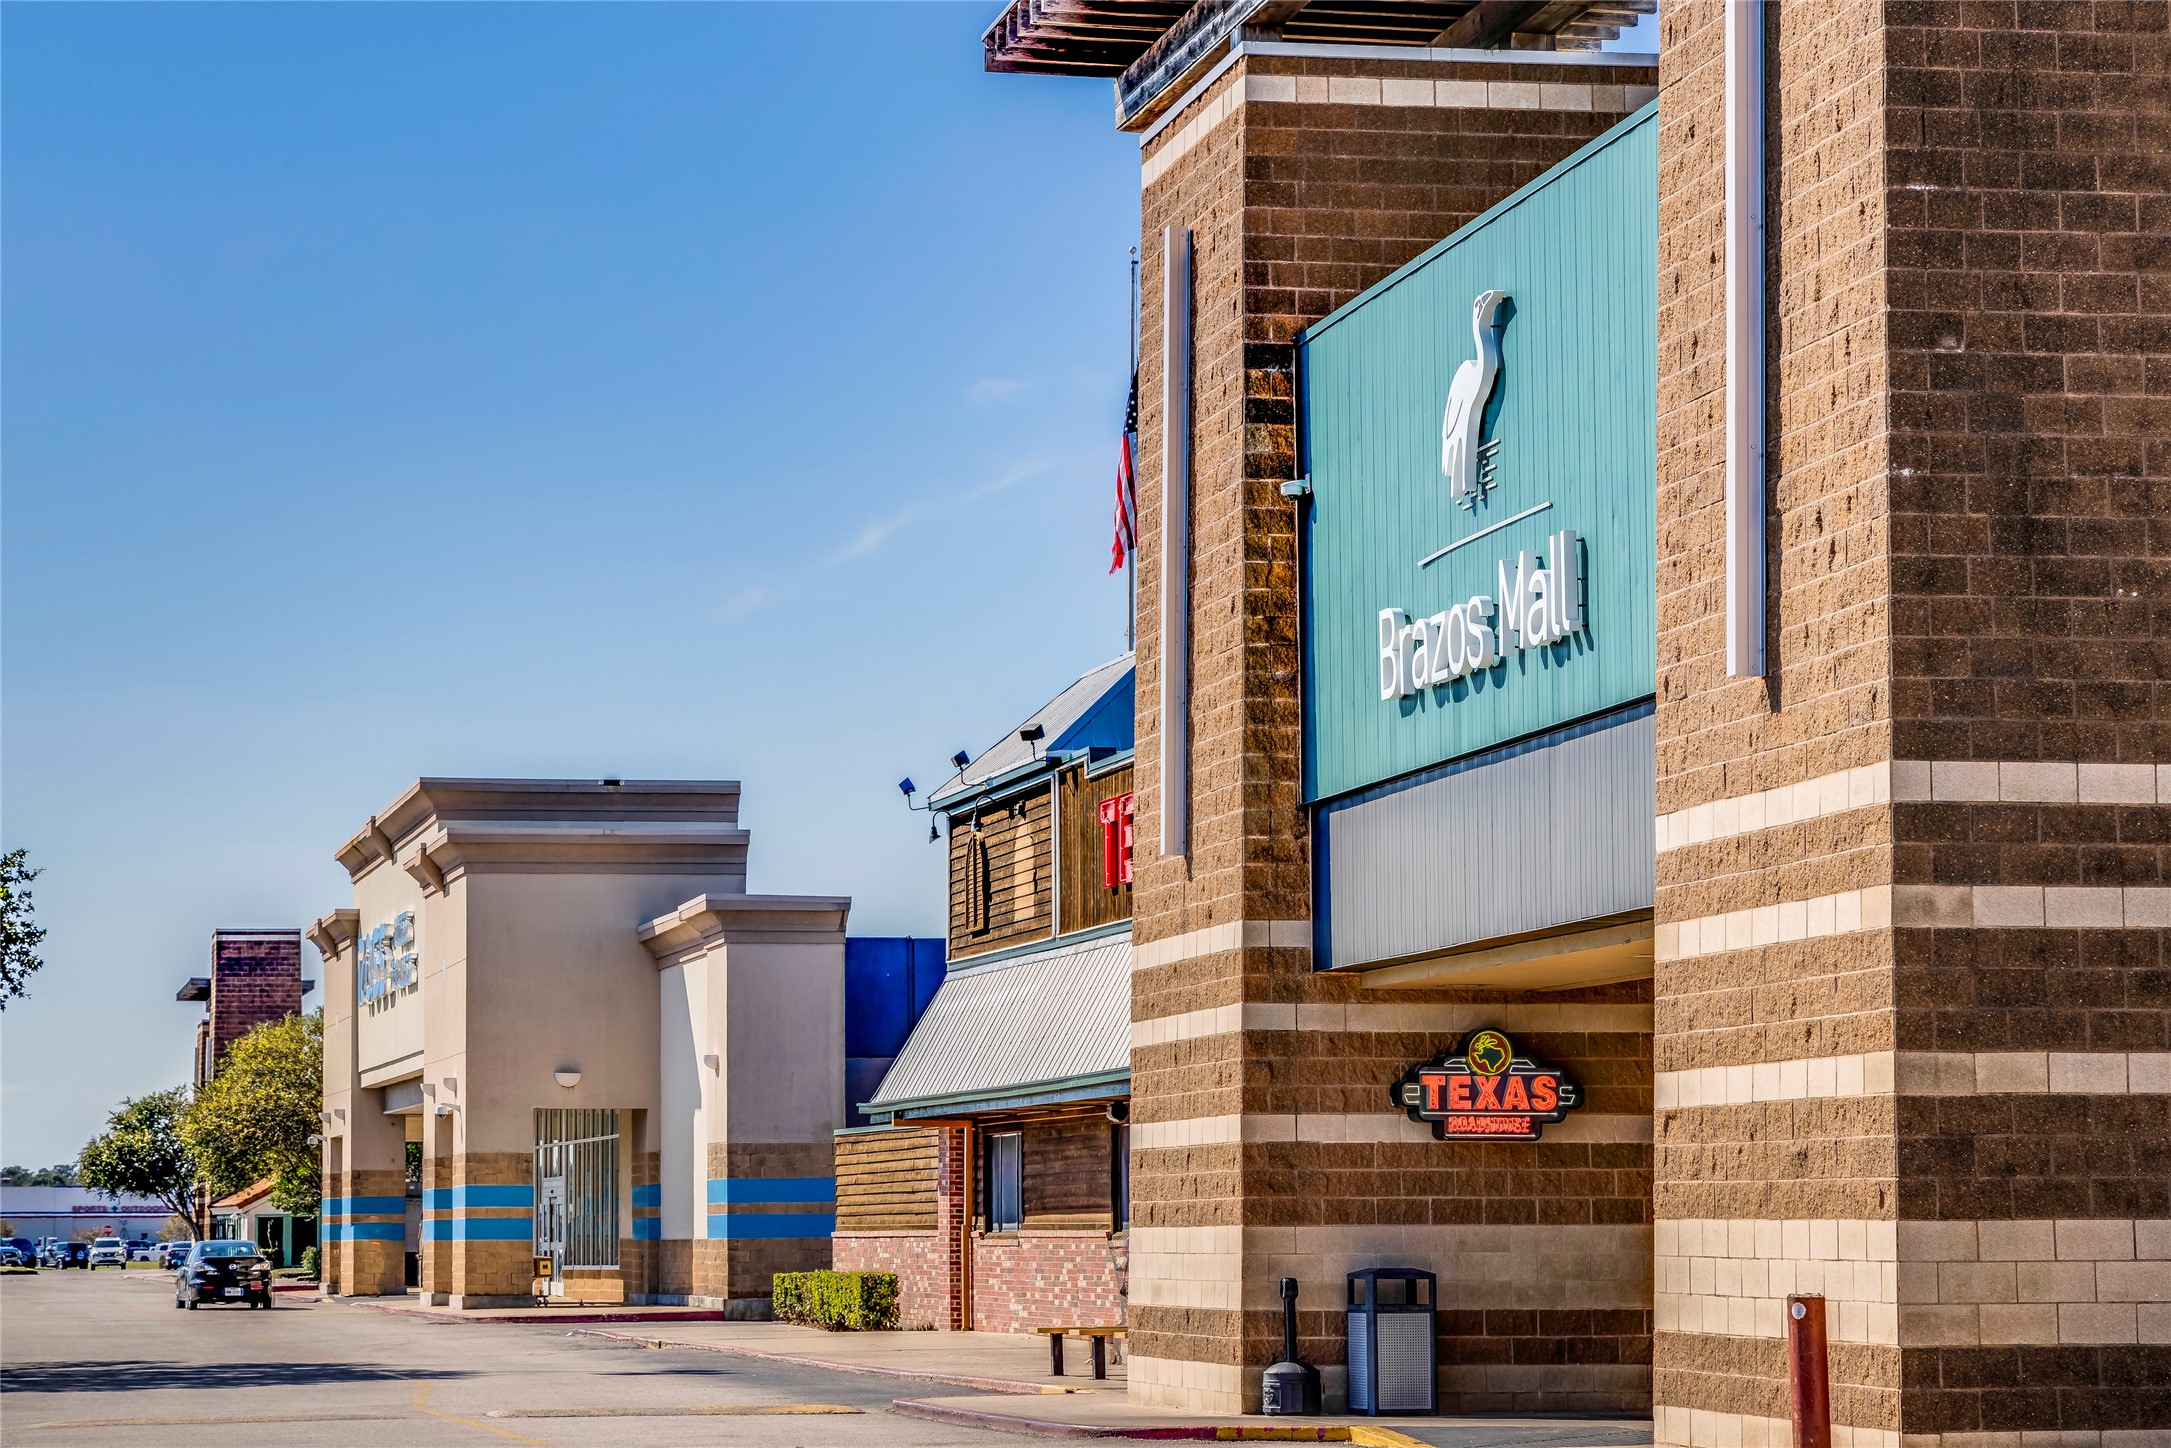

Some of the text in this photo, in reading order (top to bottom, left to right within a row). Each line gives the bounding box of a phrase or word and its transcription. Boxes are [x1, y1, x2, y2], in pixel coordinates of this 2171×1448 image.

[1378, 529, 1583, 702] Brazos Mall
[1421, 1075, 1557, 1111] TEXAS
[1447, 1115, 1531, 1134] ROADHOUSE
[71, 1205, 108, 1213] SPORTS
